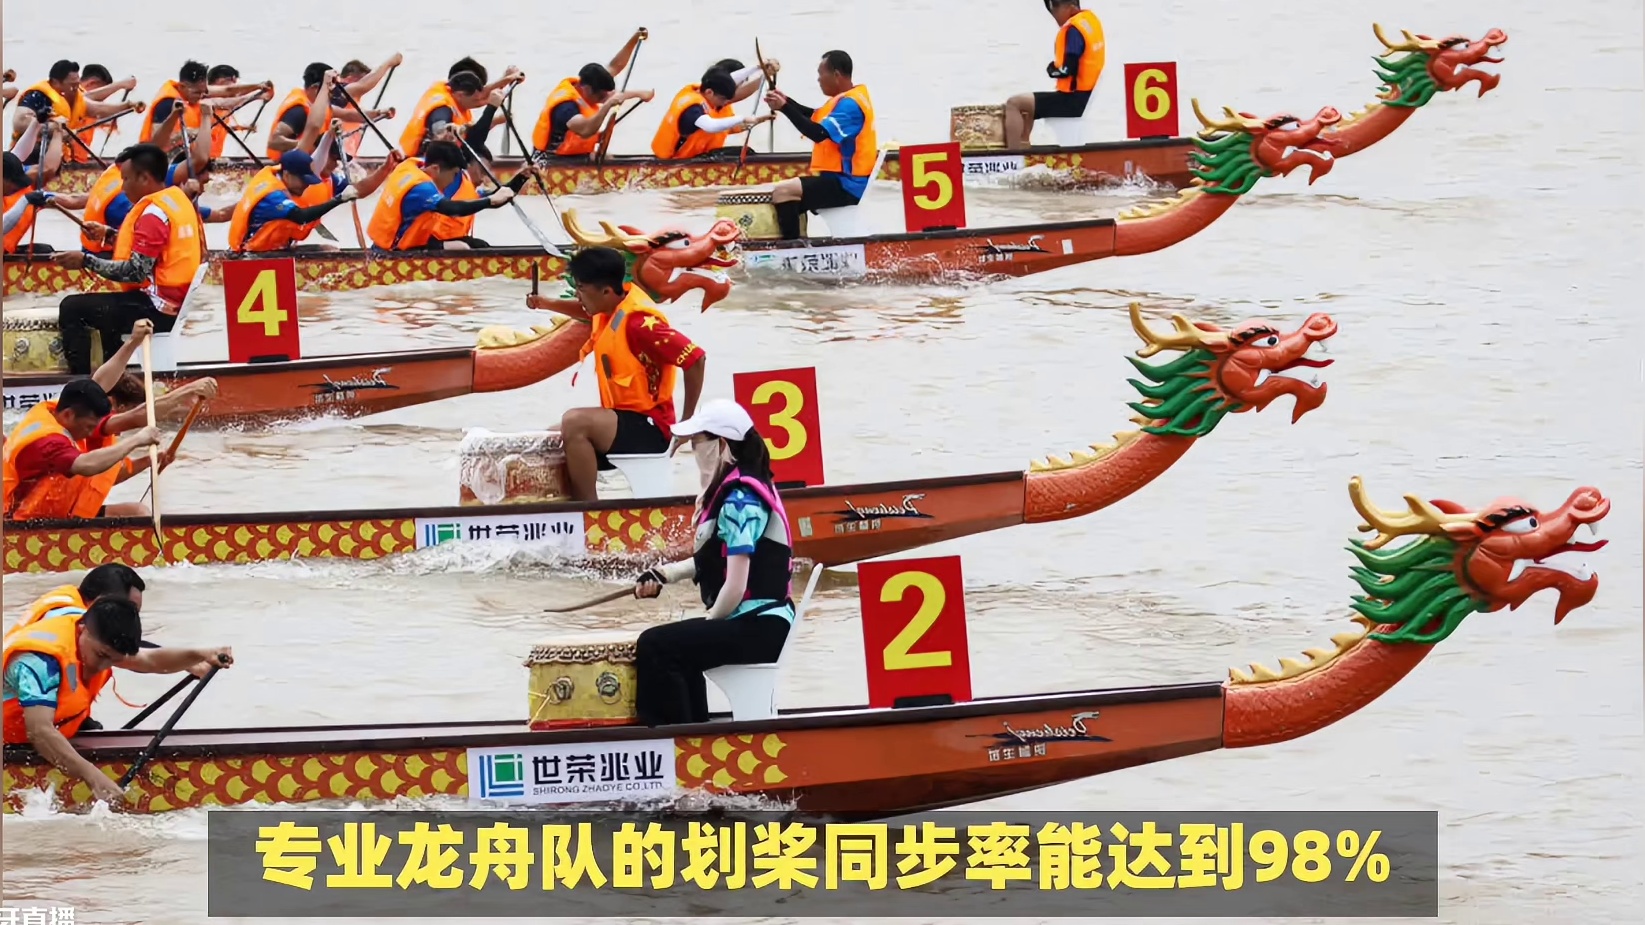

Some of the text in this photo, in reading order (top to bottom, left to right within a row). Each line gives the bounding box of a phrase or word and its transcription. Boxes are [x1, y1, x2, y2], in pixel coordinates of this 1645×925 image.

[1133, 68, 1171, 120] 6
[912, 152, 954, 211] 5
[236, 270, 288, 338] 4
[751, 380, 808, 461] 3
[880, 571, 953, 671] 2
[532, 751, 664, 785] 世荣兆业
[532, 784, 580, 796] SHIRONG
